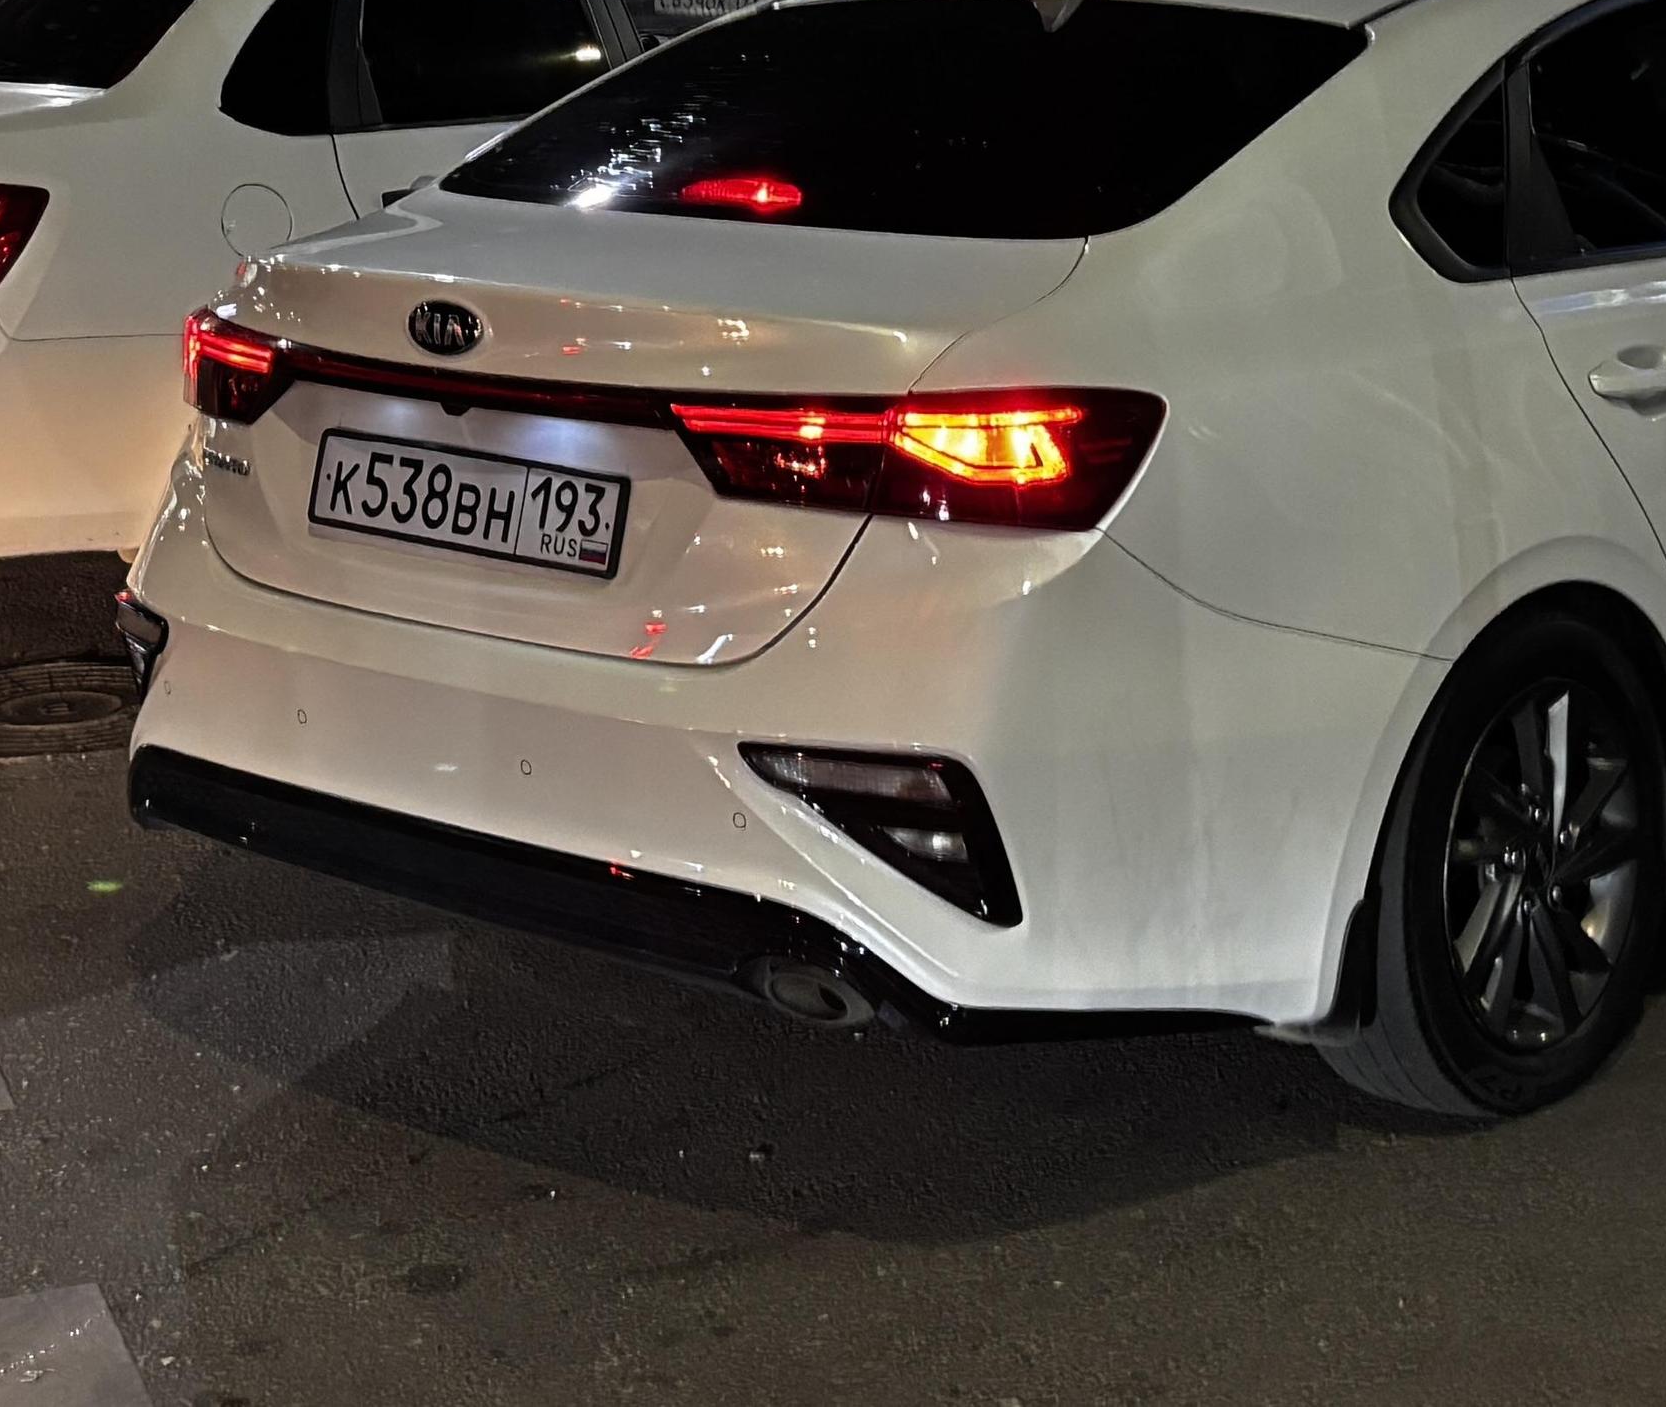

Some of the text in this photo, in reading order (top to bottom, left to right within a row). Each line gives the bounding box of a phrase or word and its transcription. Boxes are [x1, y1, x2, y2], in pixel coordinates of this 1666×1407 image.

[415, 310, 465, 346] KIA
[330, 451, 606, 543] К538ВН 193
[540, 533, 578, 558] RUS
